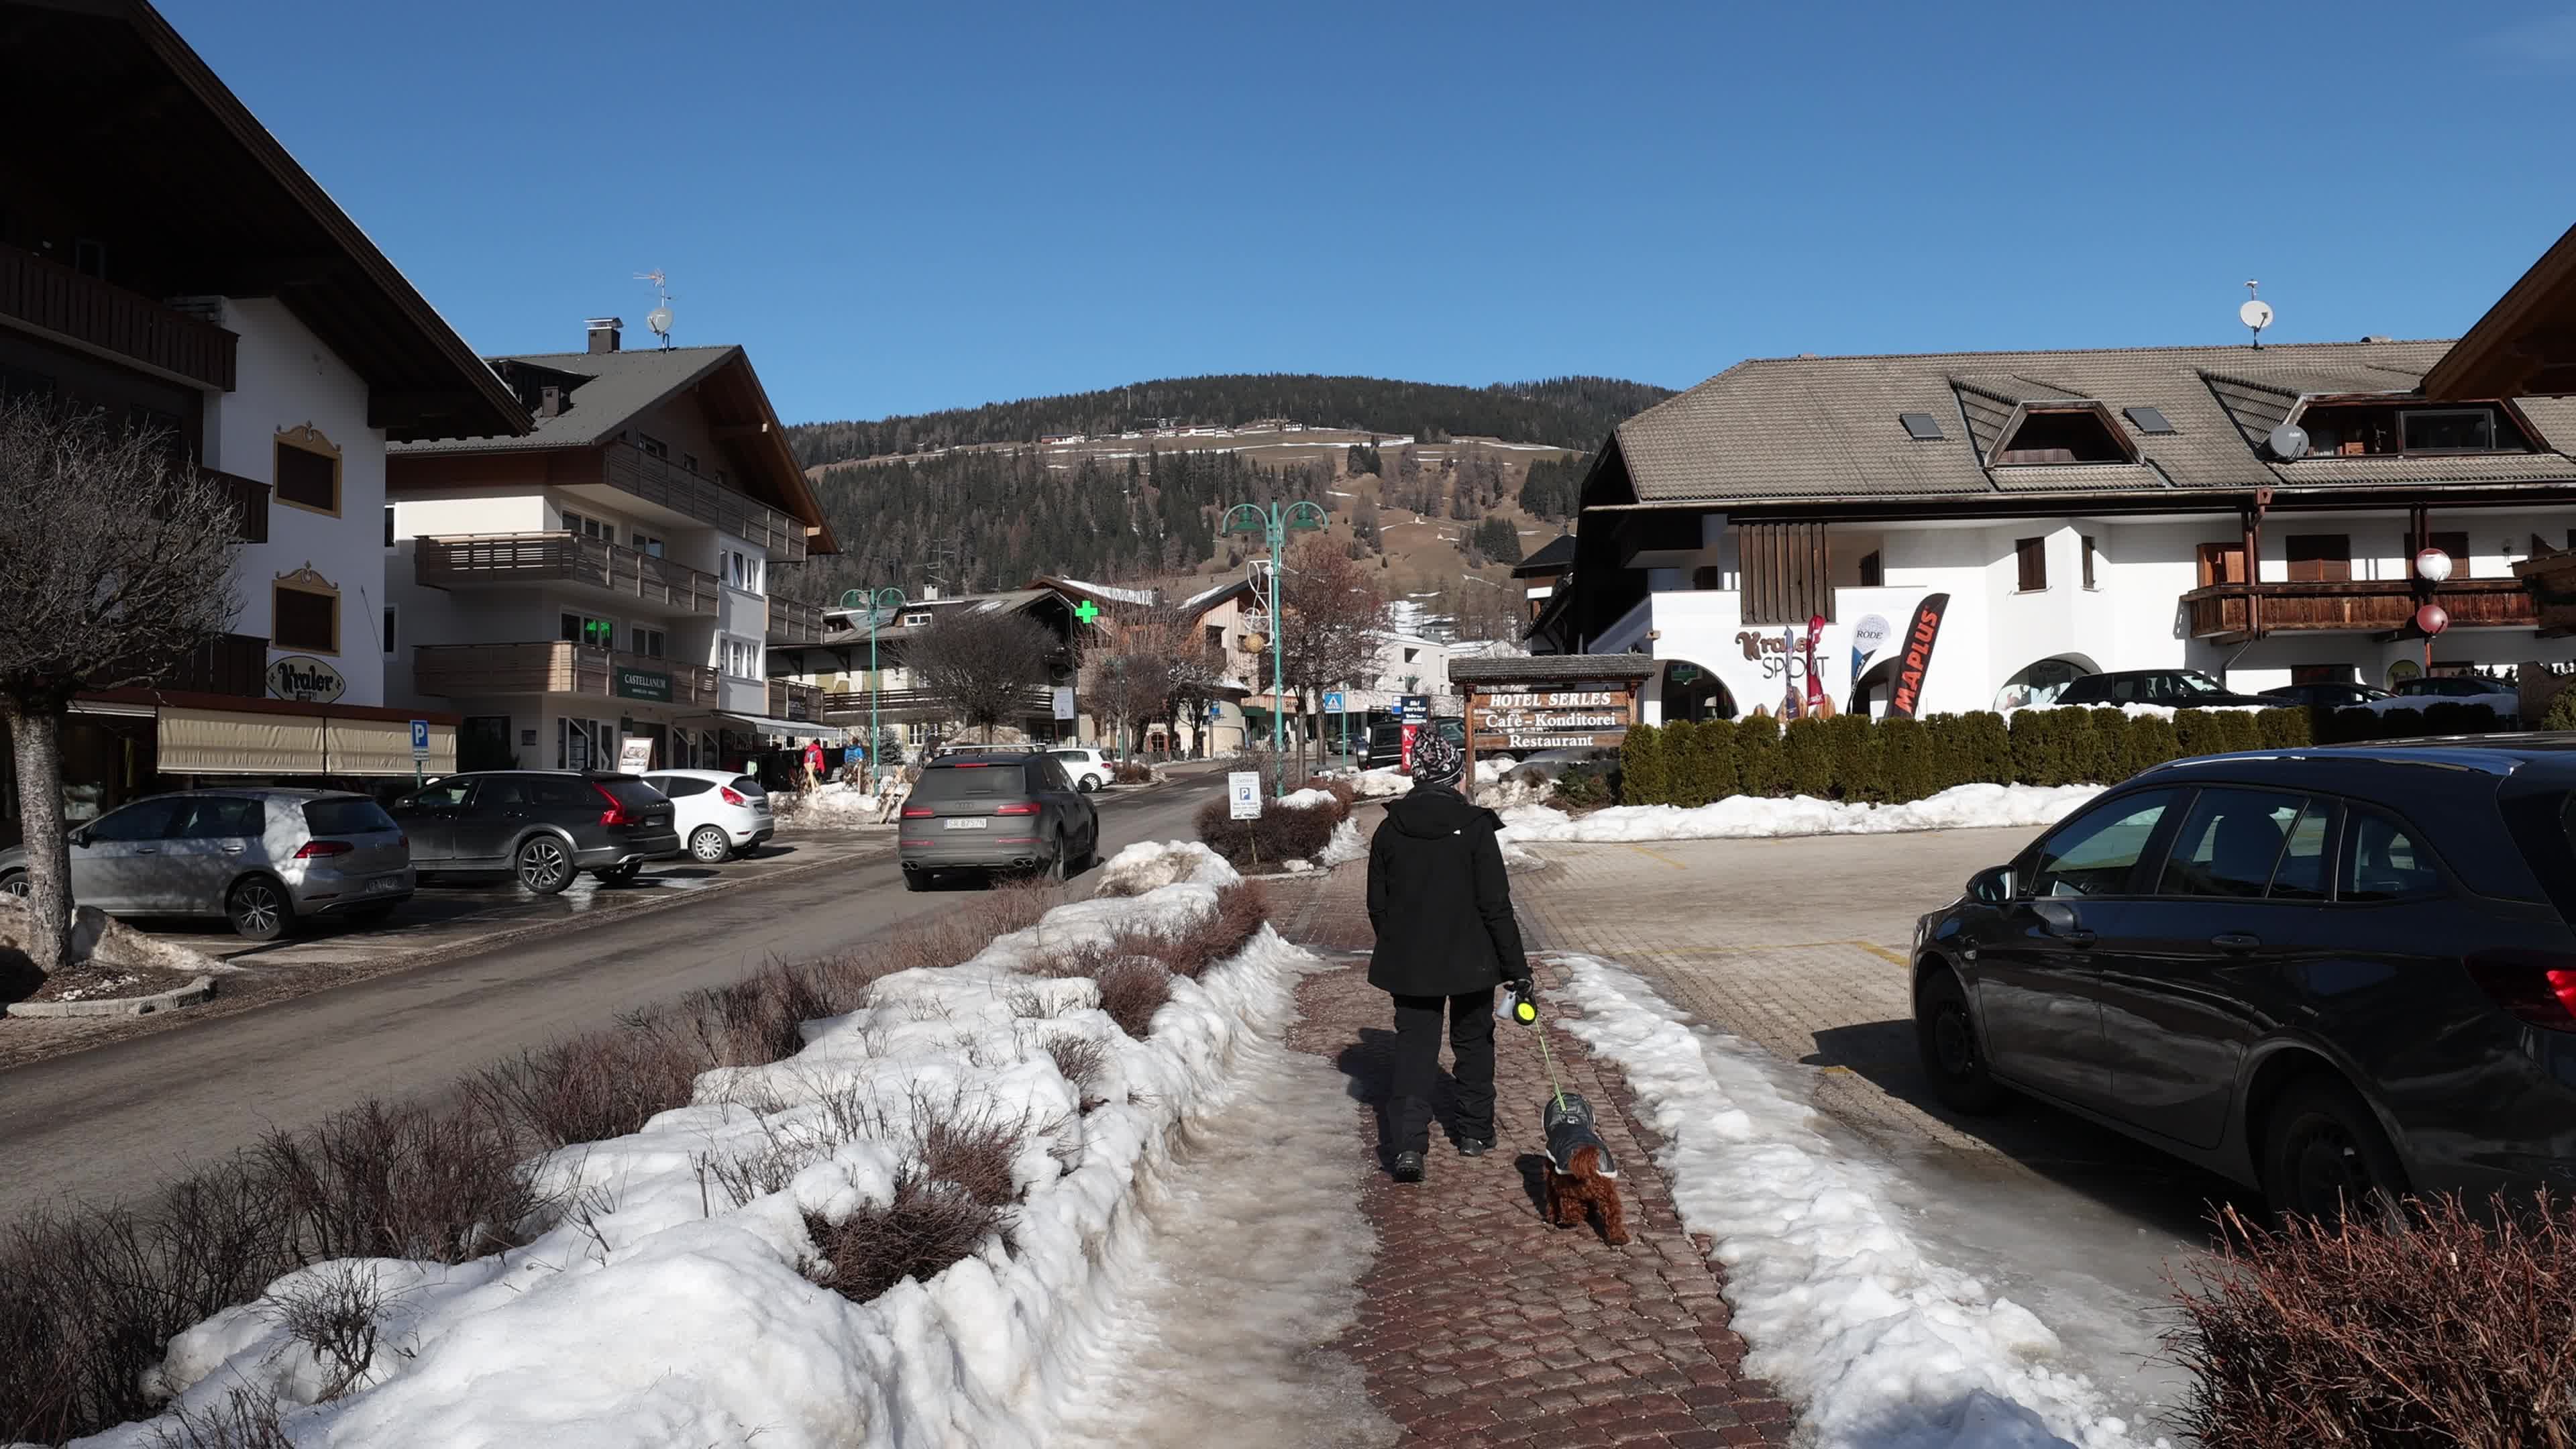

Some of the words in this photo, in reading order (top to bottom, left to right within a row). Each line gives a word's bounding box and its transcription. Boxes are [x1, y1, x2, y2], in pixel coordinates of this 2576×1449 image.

[1856, 630, 1884, 639] RODE
[1762, 656, 1829, 679] SPOT
[1895, 609, 1938, 714] MAPLUS
[1490, 694, 1542, 706] HOTEL
[1548, 692, 1611, 706] SERLES
[1535, 712, 1616, 727] Konditorei
[415, 724, 425, 744] P
[1509, 735, 1594, 747] Restaurant
[1241, 788, 1249, 800] P
